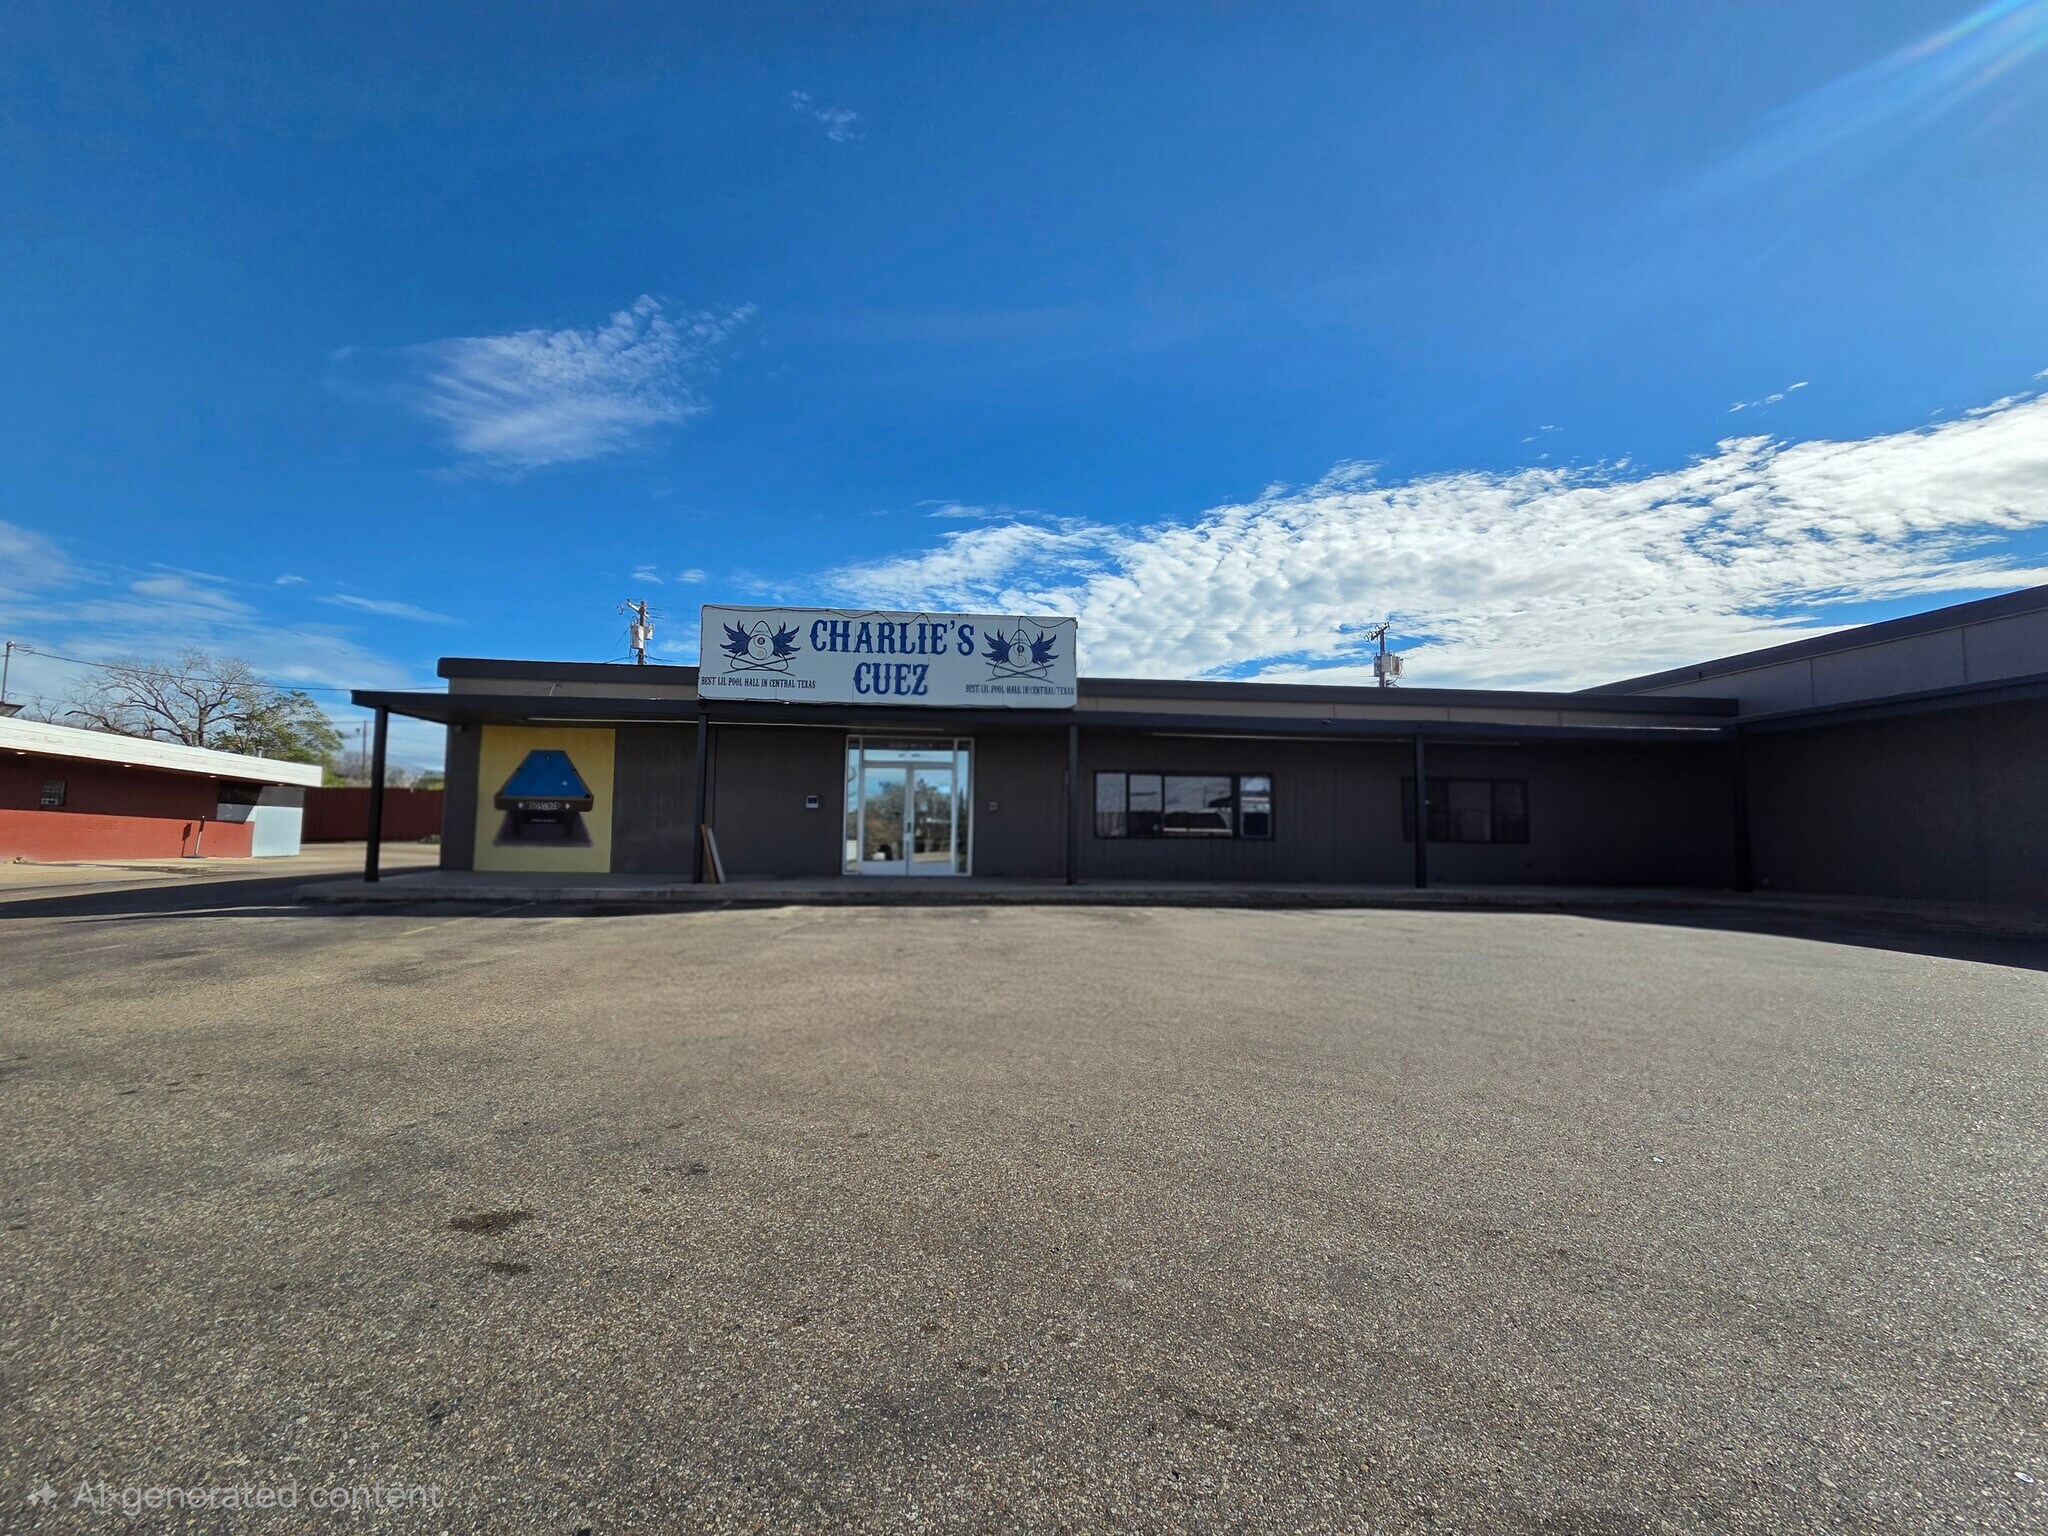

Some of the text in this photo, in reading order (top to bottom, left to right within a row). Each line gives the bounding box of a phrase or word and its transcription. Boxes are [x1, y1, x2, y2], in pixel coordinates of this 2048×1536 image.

[809, 619, 975, 656] CHARLIE'S
[701, 676, 716, 686] BEST
[728, 677, 742, 687] POOL
[744, 678, 760, 687] HALL
[761, 679, 768, 688] IN
[769, 679, 796, 688] CENTRAL
[797, 679, 817, 689] TEXAS
[853, 661, 930, 696] CUEZ
[965, 683, 980, 693] BEST
[991, 684, 1005, 694] POOL
[1006, 685, 1021, 694] HALL
[1022, 685, 1029, 695] IN
[1030, 686, 1055, 695] CENTRAL
[1056, 686, 1076, 695] TEXAS
